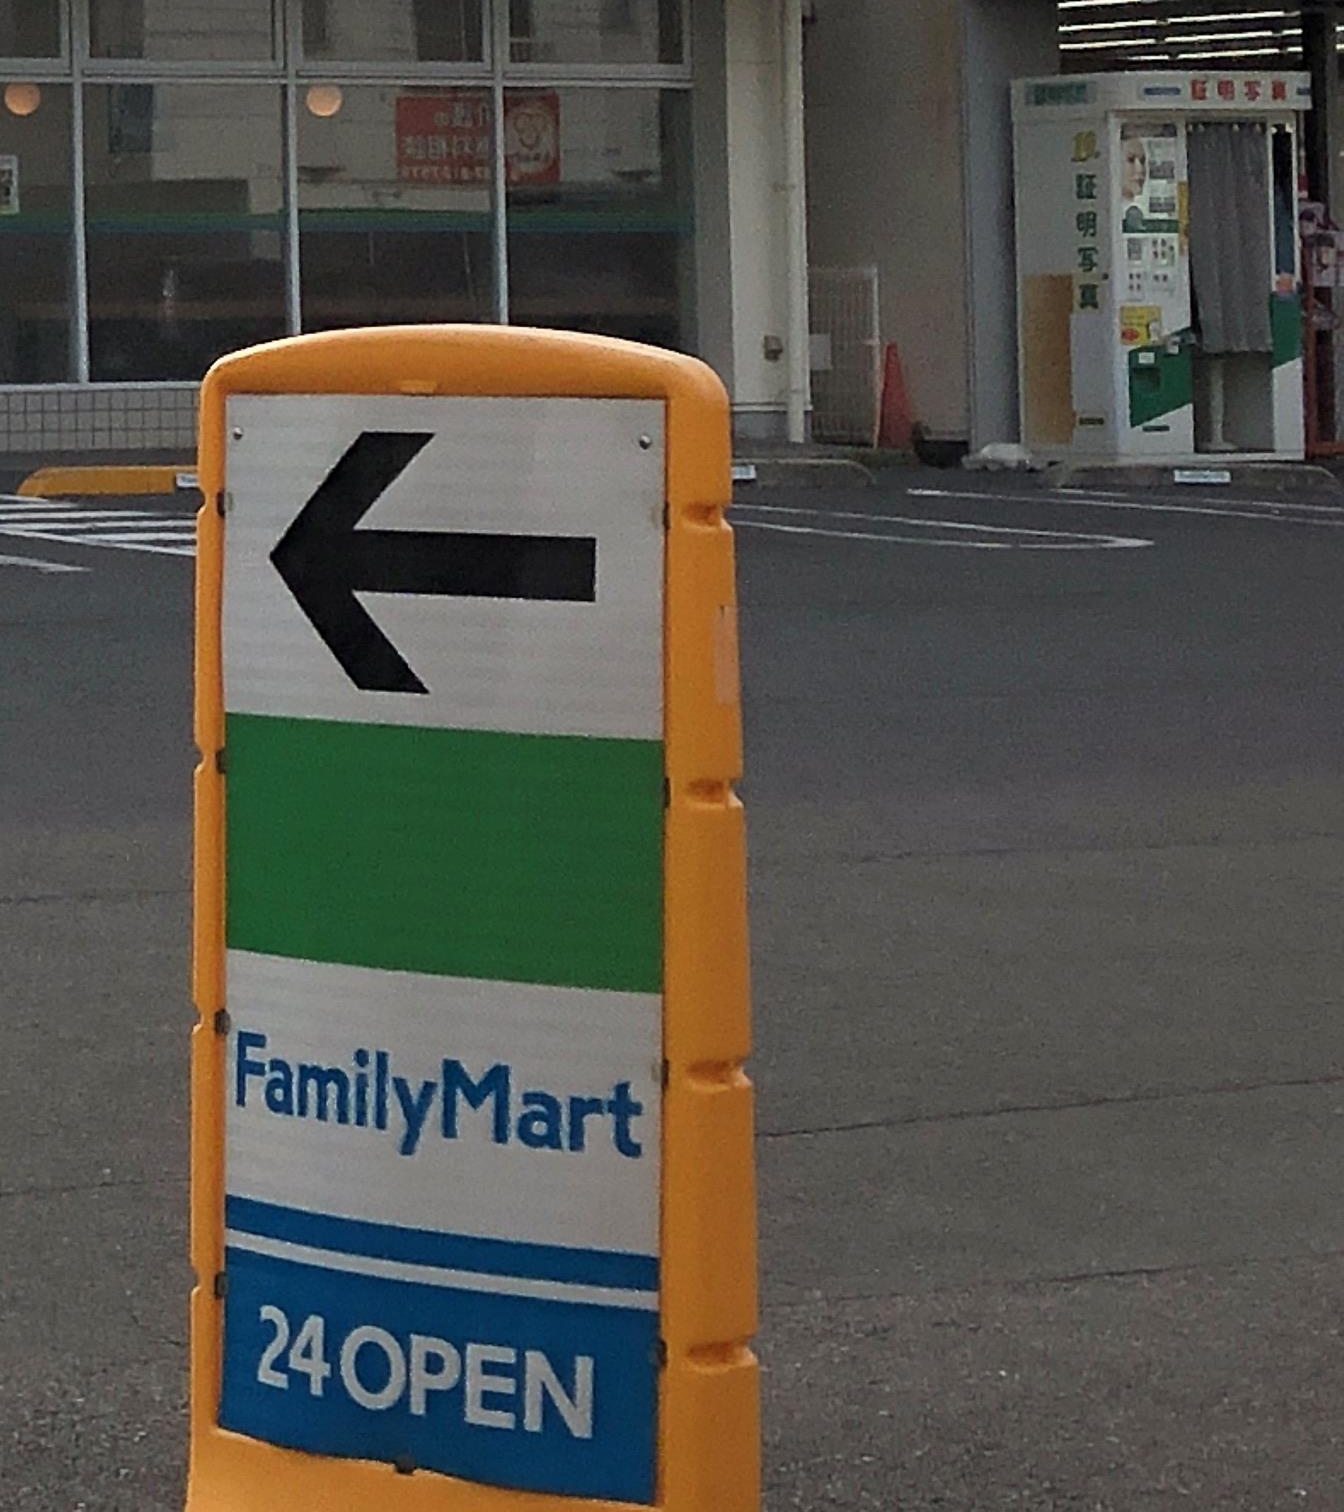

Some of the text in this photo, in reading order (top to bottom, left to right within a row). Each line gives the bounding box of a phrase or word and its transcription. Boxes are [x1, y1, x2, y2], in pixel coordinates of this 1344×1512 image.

[1075, 173, 1101, 310] 証明写真
[235, 1030, 643, 1159] FamilyMart
[256, 1303, 595, 1439] 24OPEN
